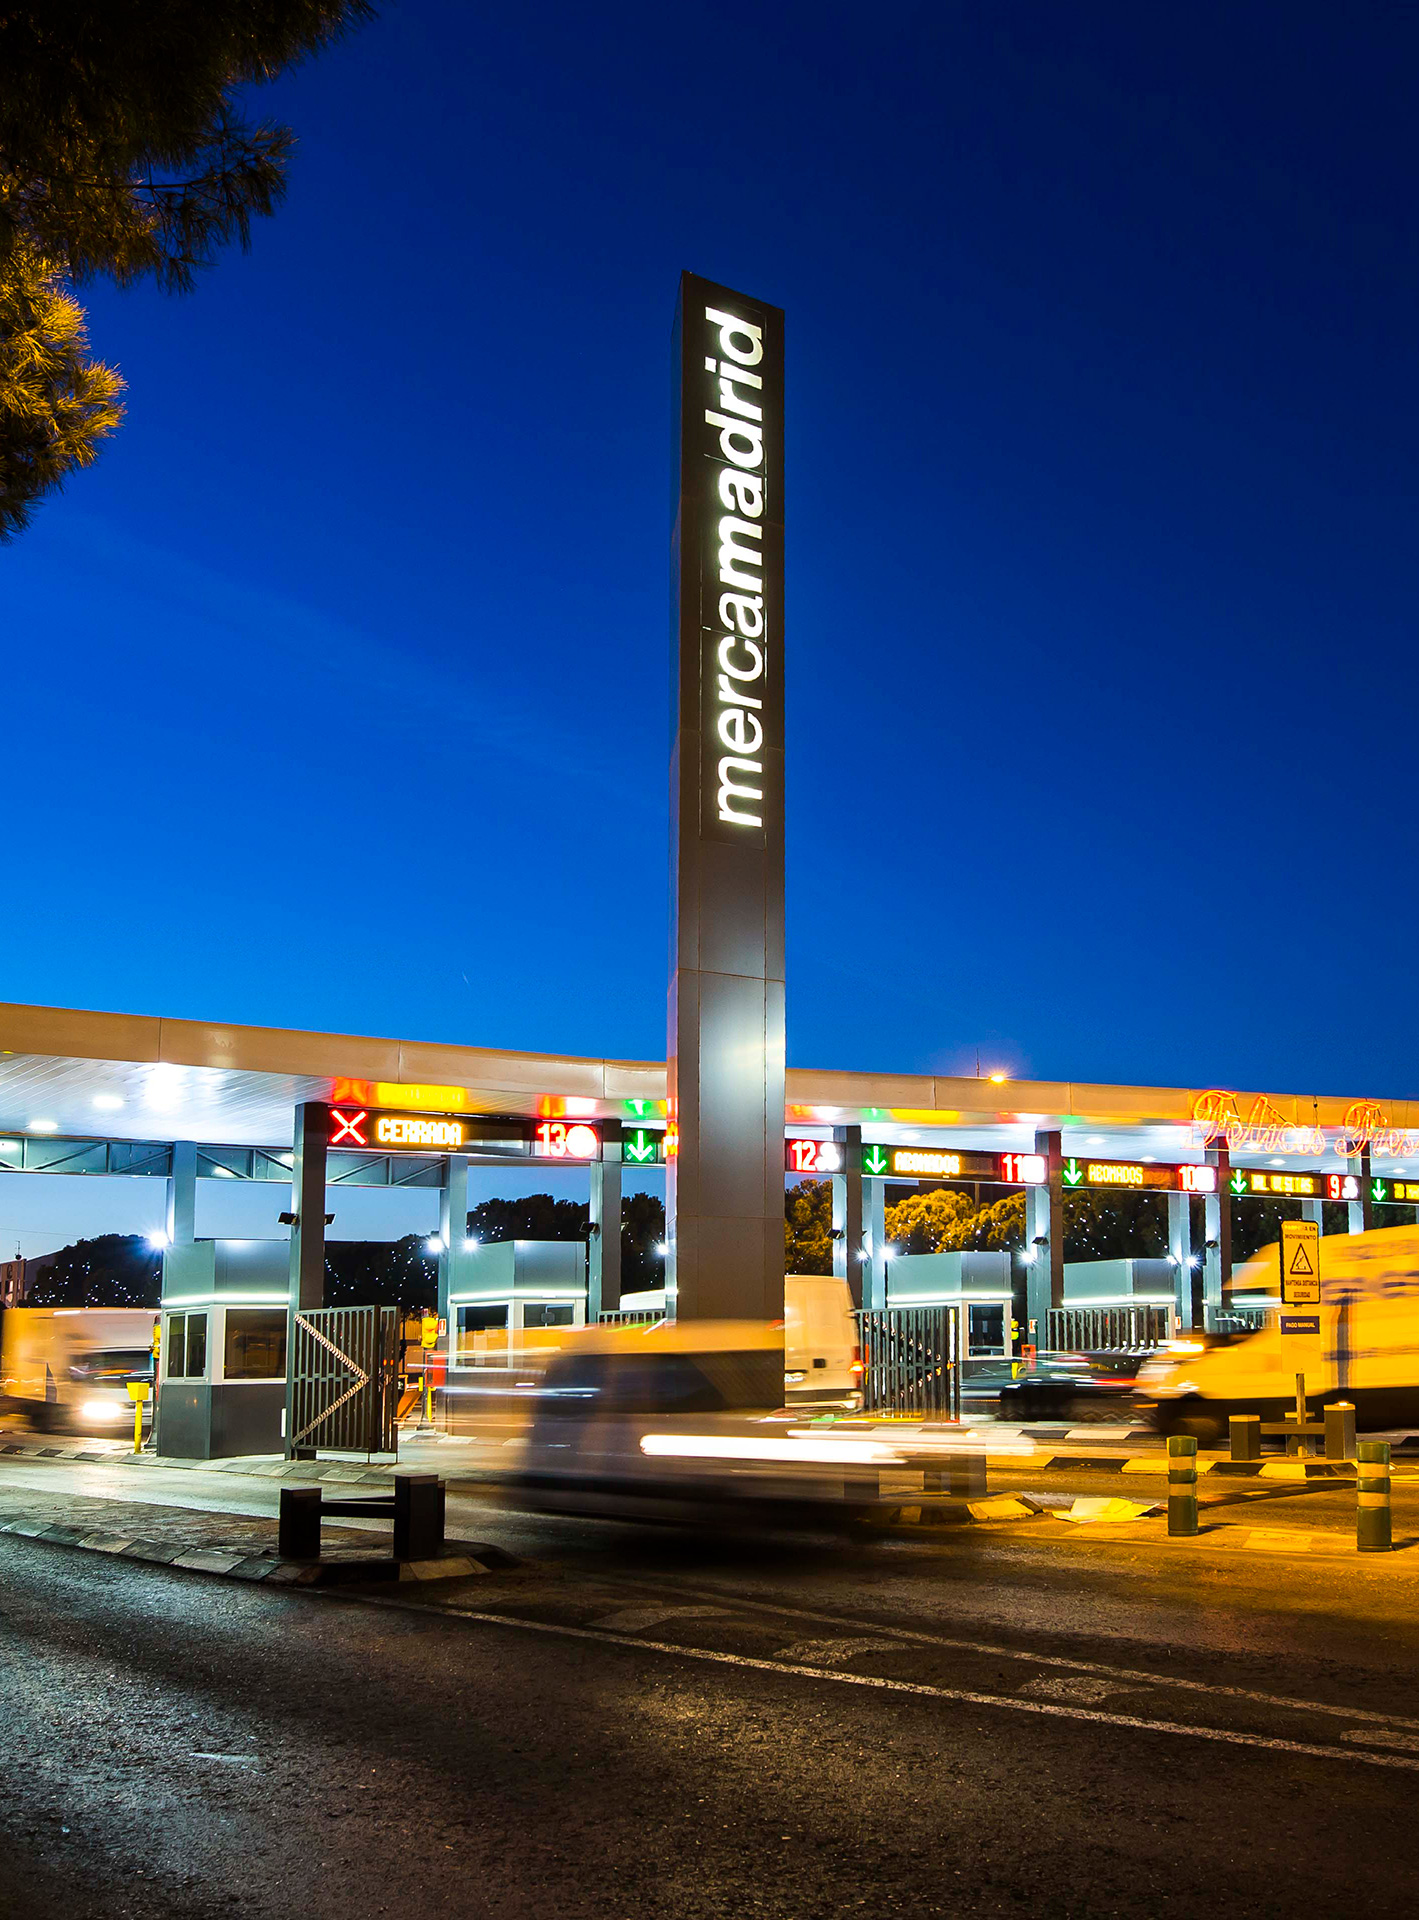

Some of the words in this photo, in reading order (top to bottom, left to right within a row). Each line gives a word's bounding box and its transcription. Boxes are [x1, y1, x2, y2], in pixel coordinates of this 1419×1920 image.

[704, 306, 765, 829] mercamadrid
[378, 1118, 462, 1146] CERRADA
[537, 1122, 567, 1157] 13
[791, 1140, 817, 1171] 12
[1003, 1154, 1023, 1182] 11
[1088, 1163, 1144, 1185] ABONADOS
[1178, 1165, 1197, 1191] 10
[1330, 1175, 1341, 1198] 9
